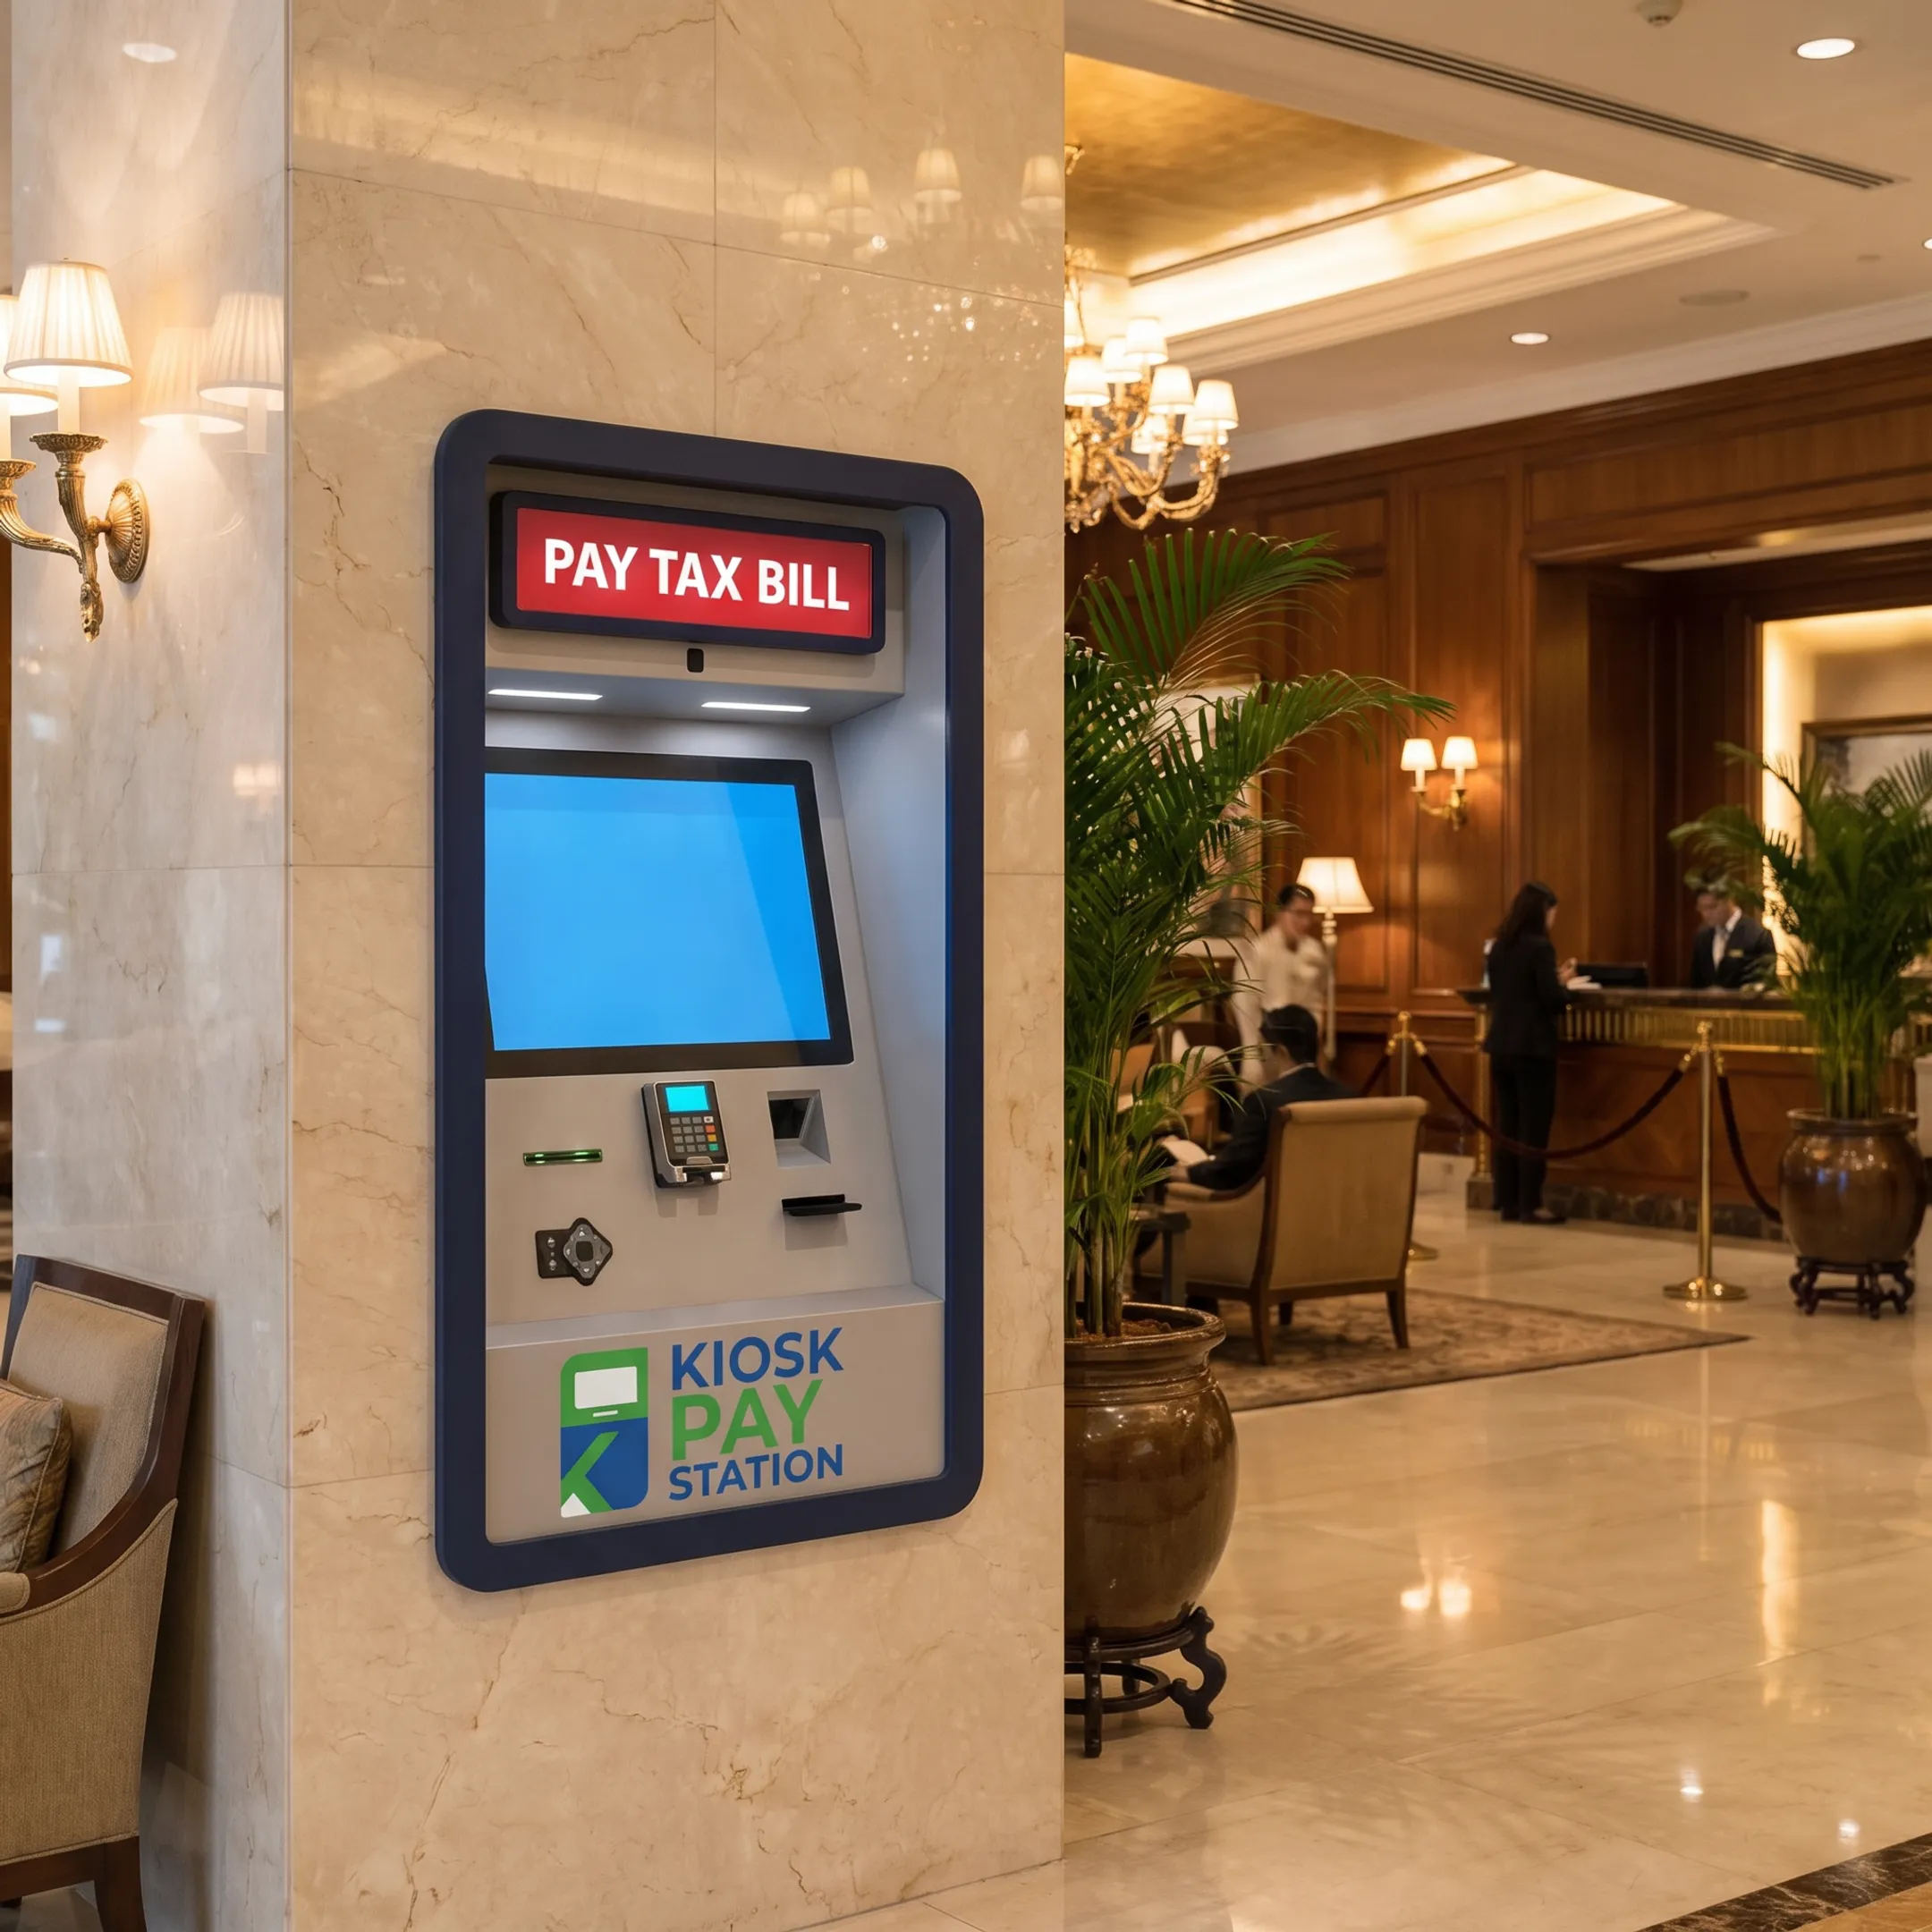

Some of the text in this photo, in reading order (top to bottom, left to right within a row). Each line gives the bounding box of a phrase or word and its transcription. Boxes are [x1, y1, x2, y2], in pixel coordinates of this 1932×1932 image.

[544, 538, 851, 611] PAY TAX BILL
[672, 1327, 844, 1391] KIOSK
[671, 1379, 823, 1462] PAY
[668, 1444, 843, 1501] STATION
